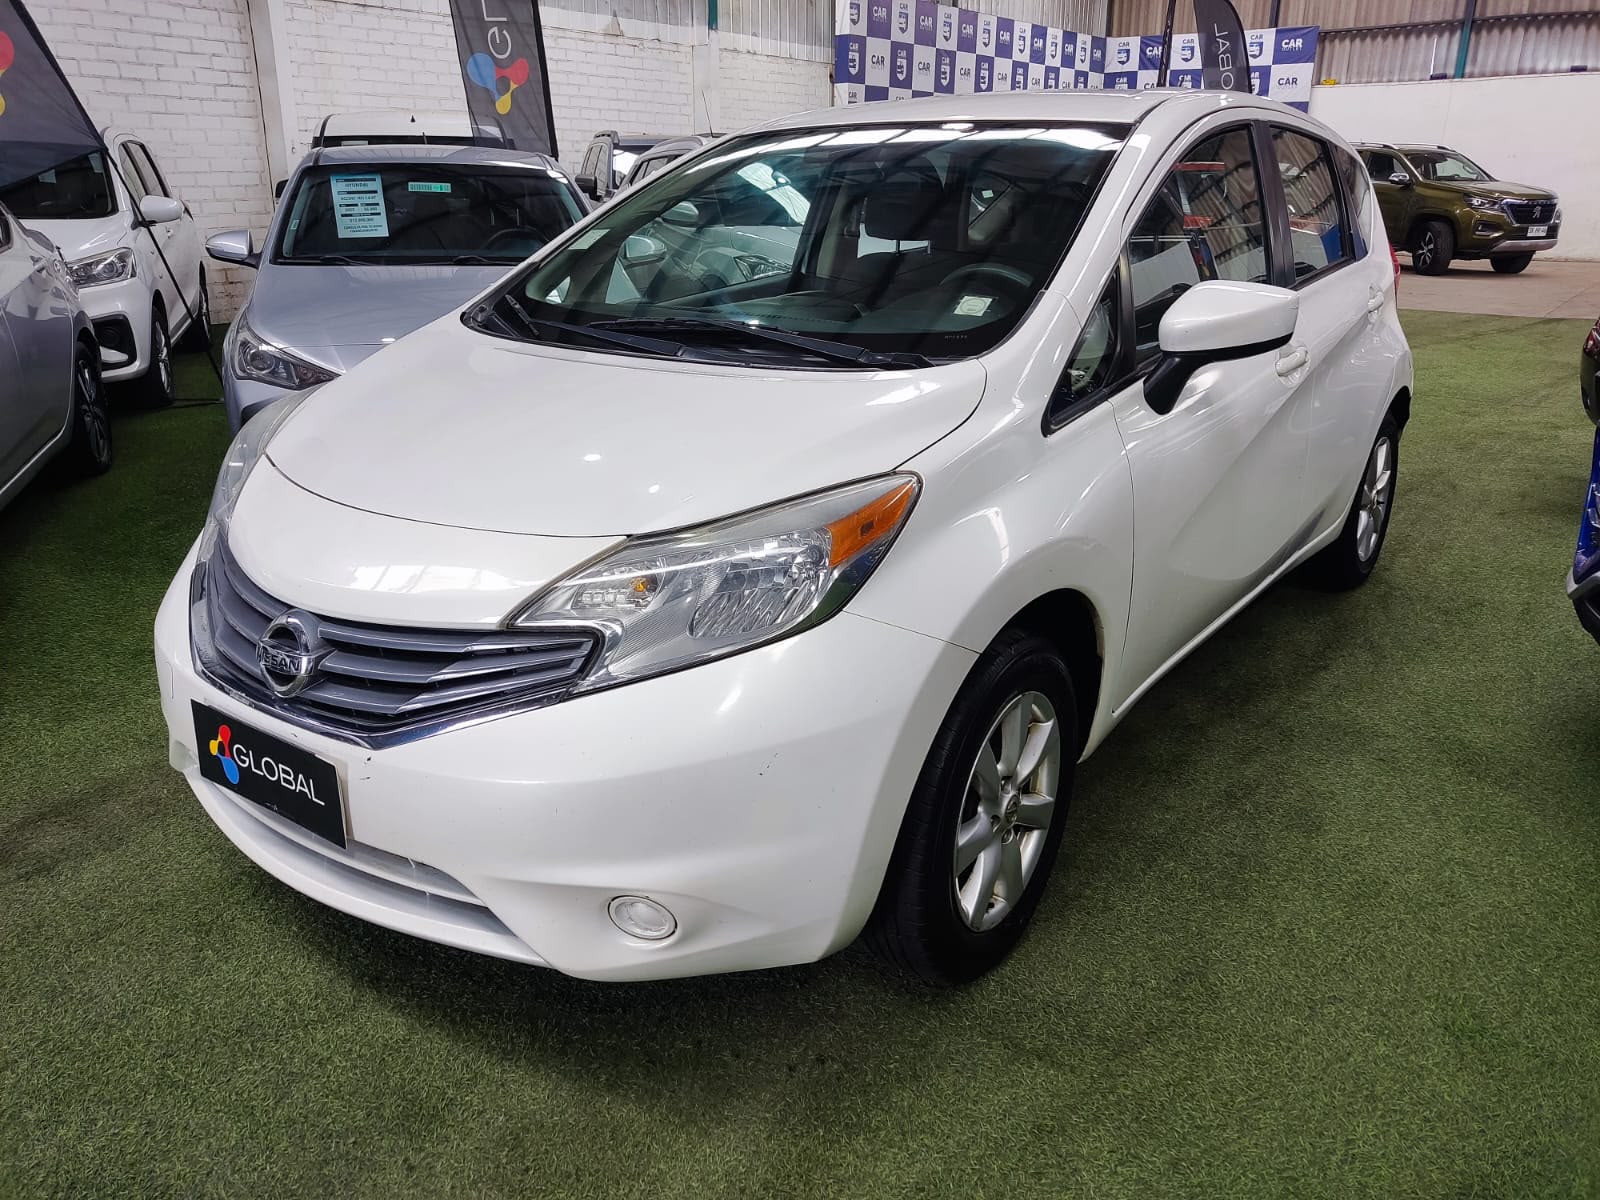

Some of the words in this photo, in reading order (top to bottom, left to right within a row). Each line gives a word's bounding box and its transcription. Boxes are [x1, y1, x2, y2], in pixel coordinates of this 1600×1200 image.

[872, 6, 887, 18] CAR
[920, 15, 933, 27] CAR
[962, 23, 973, 35] CAR
[1000, 30, 1010, 41] CAR
[1281, 38, 1303, 48] CAR
[871, 54, 885, 66] CAR
[918, 61, 931, 72] CAR
[960, 67, 971, 77] CAR
[997, 73, 1007, 81] CAR
[1277, 77, 1298, 86] CAR
[233, 744, 326, 806] GLOBAL
